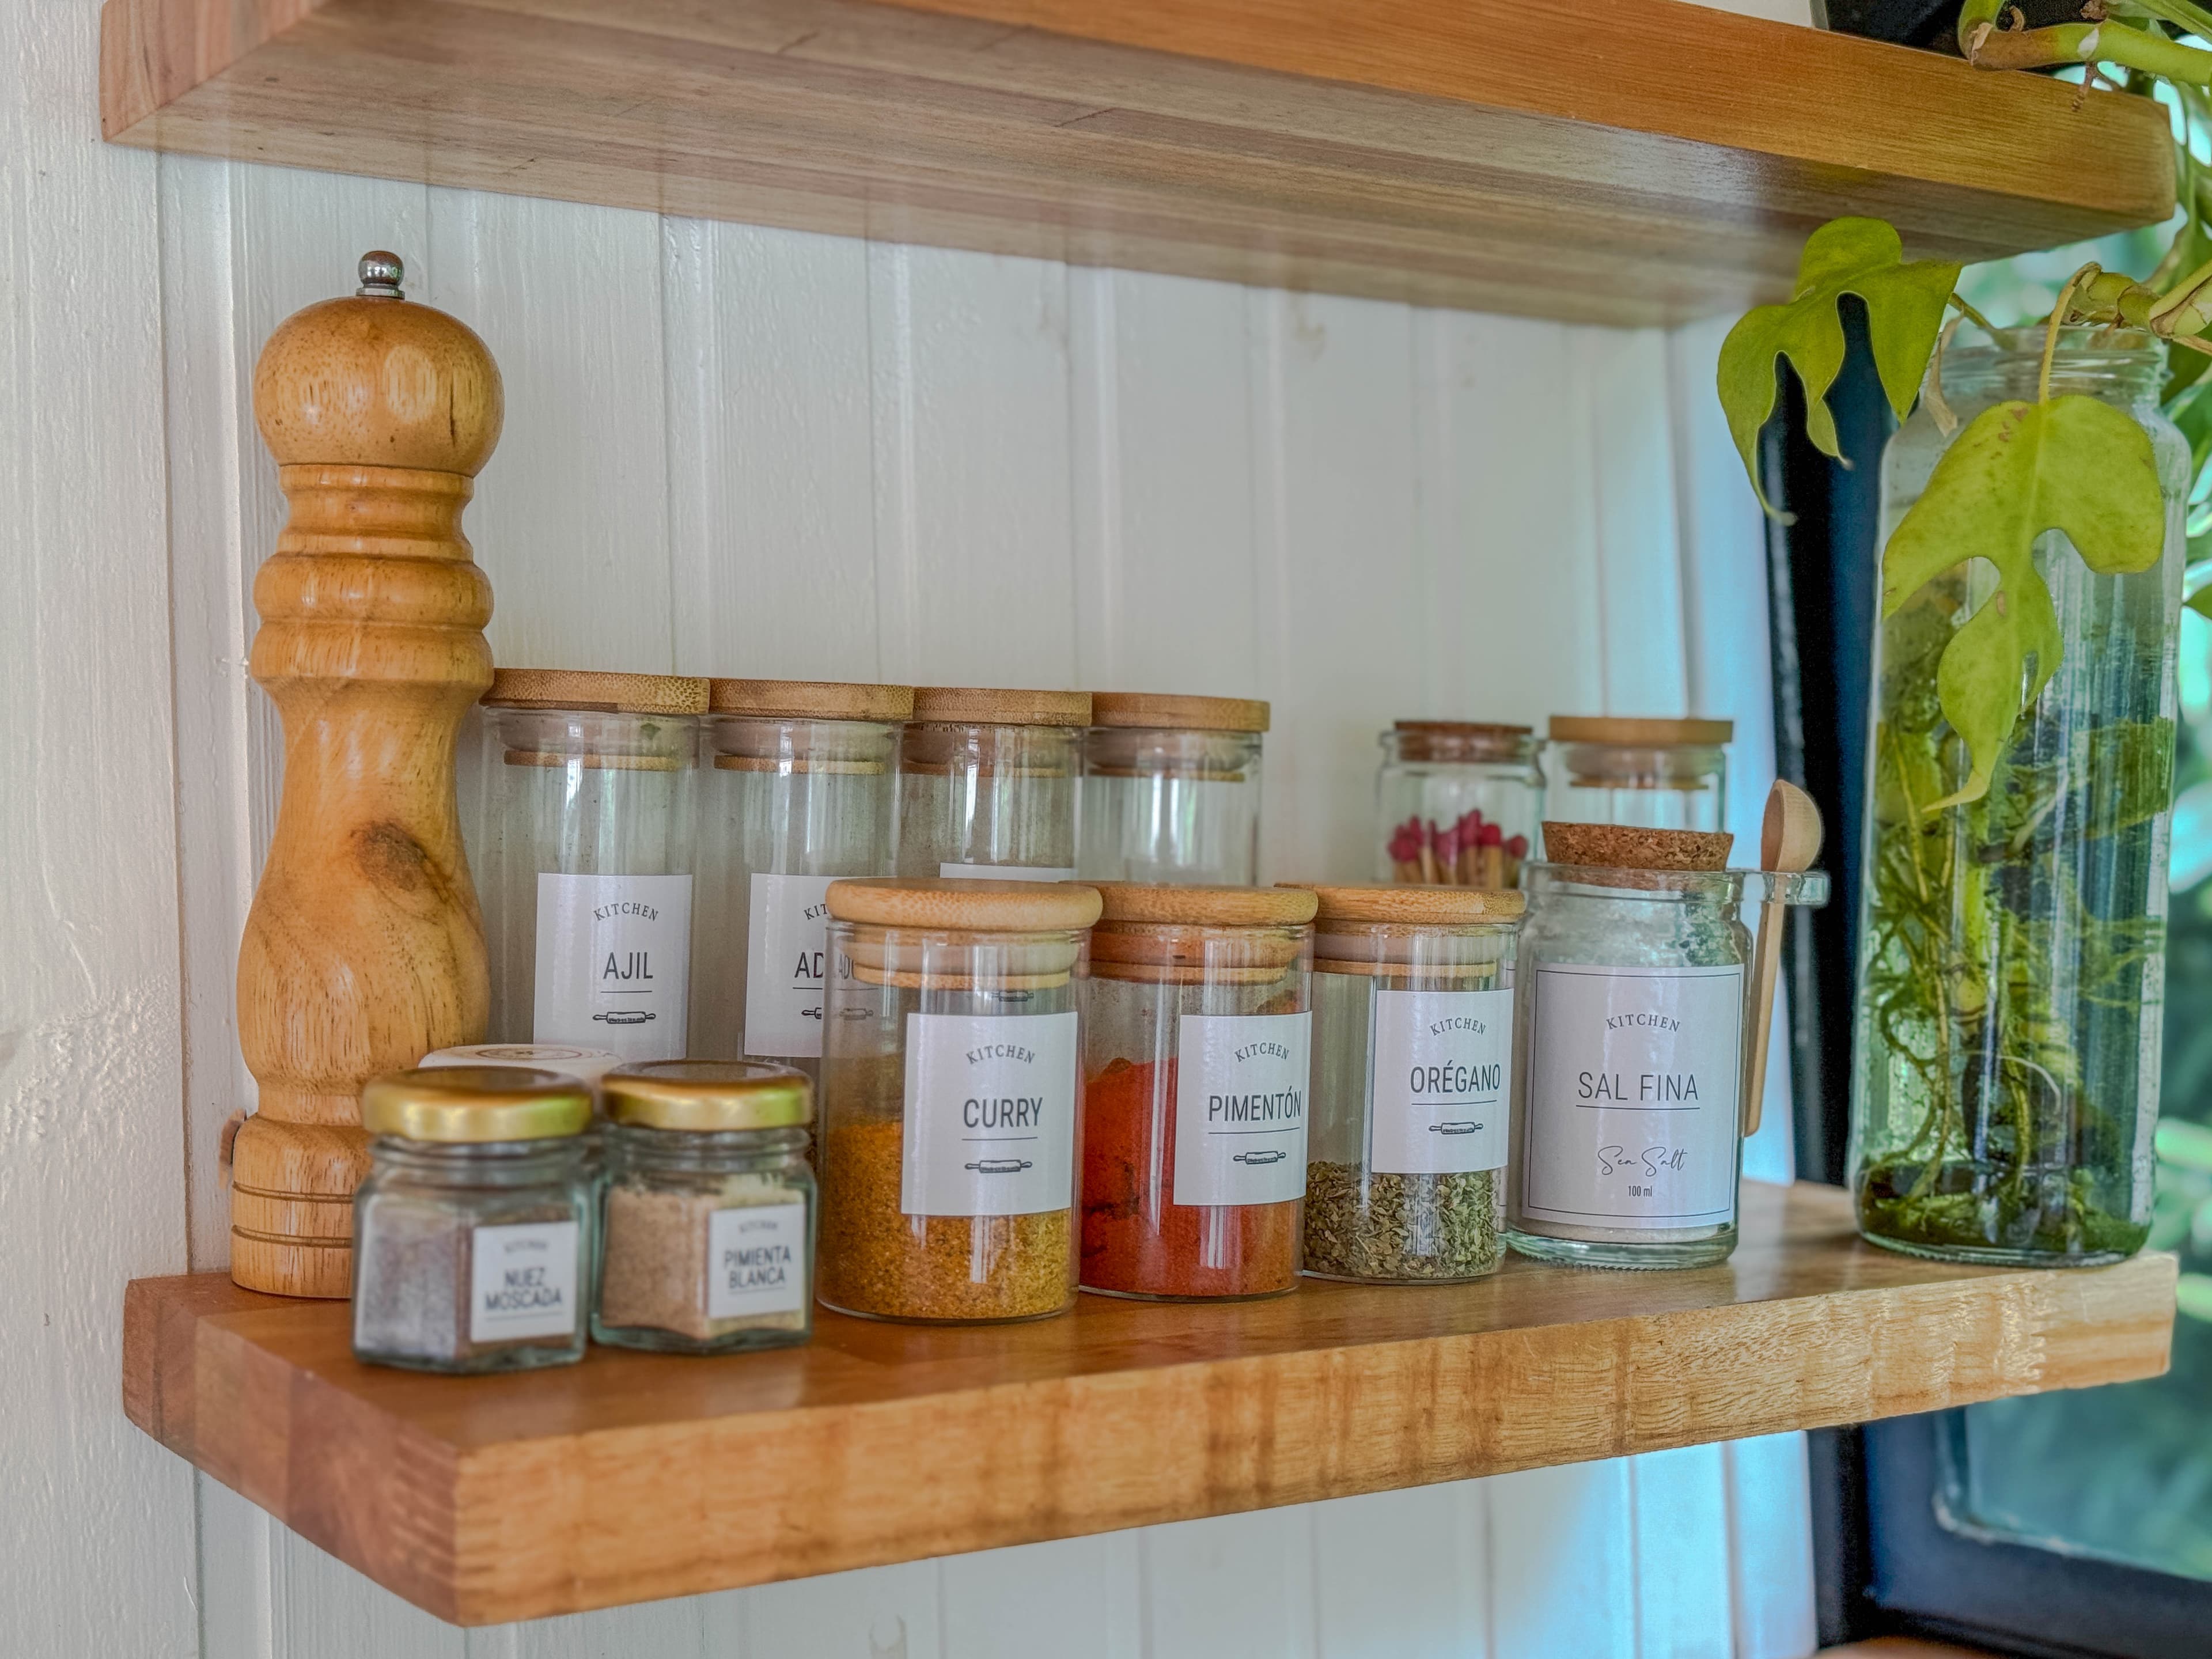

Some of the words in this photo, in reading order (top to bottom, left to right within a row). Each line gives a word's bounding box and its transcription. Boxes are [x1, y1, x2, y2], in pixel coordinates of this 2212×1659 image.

[593, 902, 658, 921] KITCHEN
[603, 952, 653, 979] AJIL
[1429, 1017, 1487, 1036] KITCHEN
[1606, 1013, 1680, 1032] KITCHEN
[966, 1044, 1035, 1065] KITCHEN
[1234, 1042, 1290, 1062] KITCHEN
[1410, 1059, 1501, 1093] ORÉGANO
[1578, 1071, 1628, 1100] SAL
[1640, 1074, 1699, 1101] FINA
[964, 1097, 1043, 1128] CURRY
[1209, 1085, 1302, 1122] PIMENTÓN
[1597, 1145, 1637, 1176] Sea
[1641, 1146, 1688, 1177] Salt
[1628, 1185, 1642, 1197] 100
[1643, 1185, 1653, 1197] ml
[724, 1245, 791, 1269] PIMIENTA
[505, 1267, 546, 1286] NUEZ
[729, 1267, 785, 1289] BLANCA
